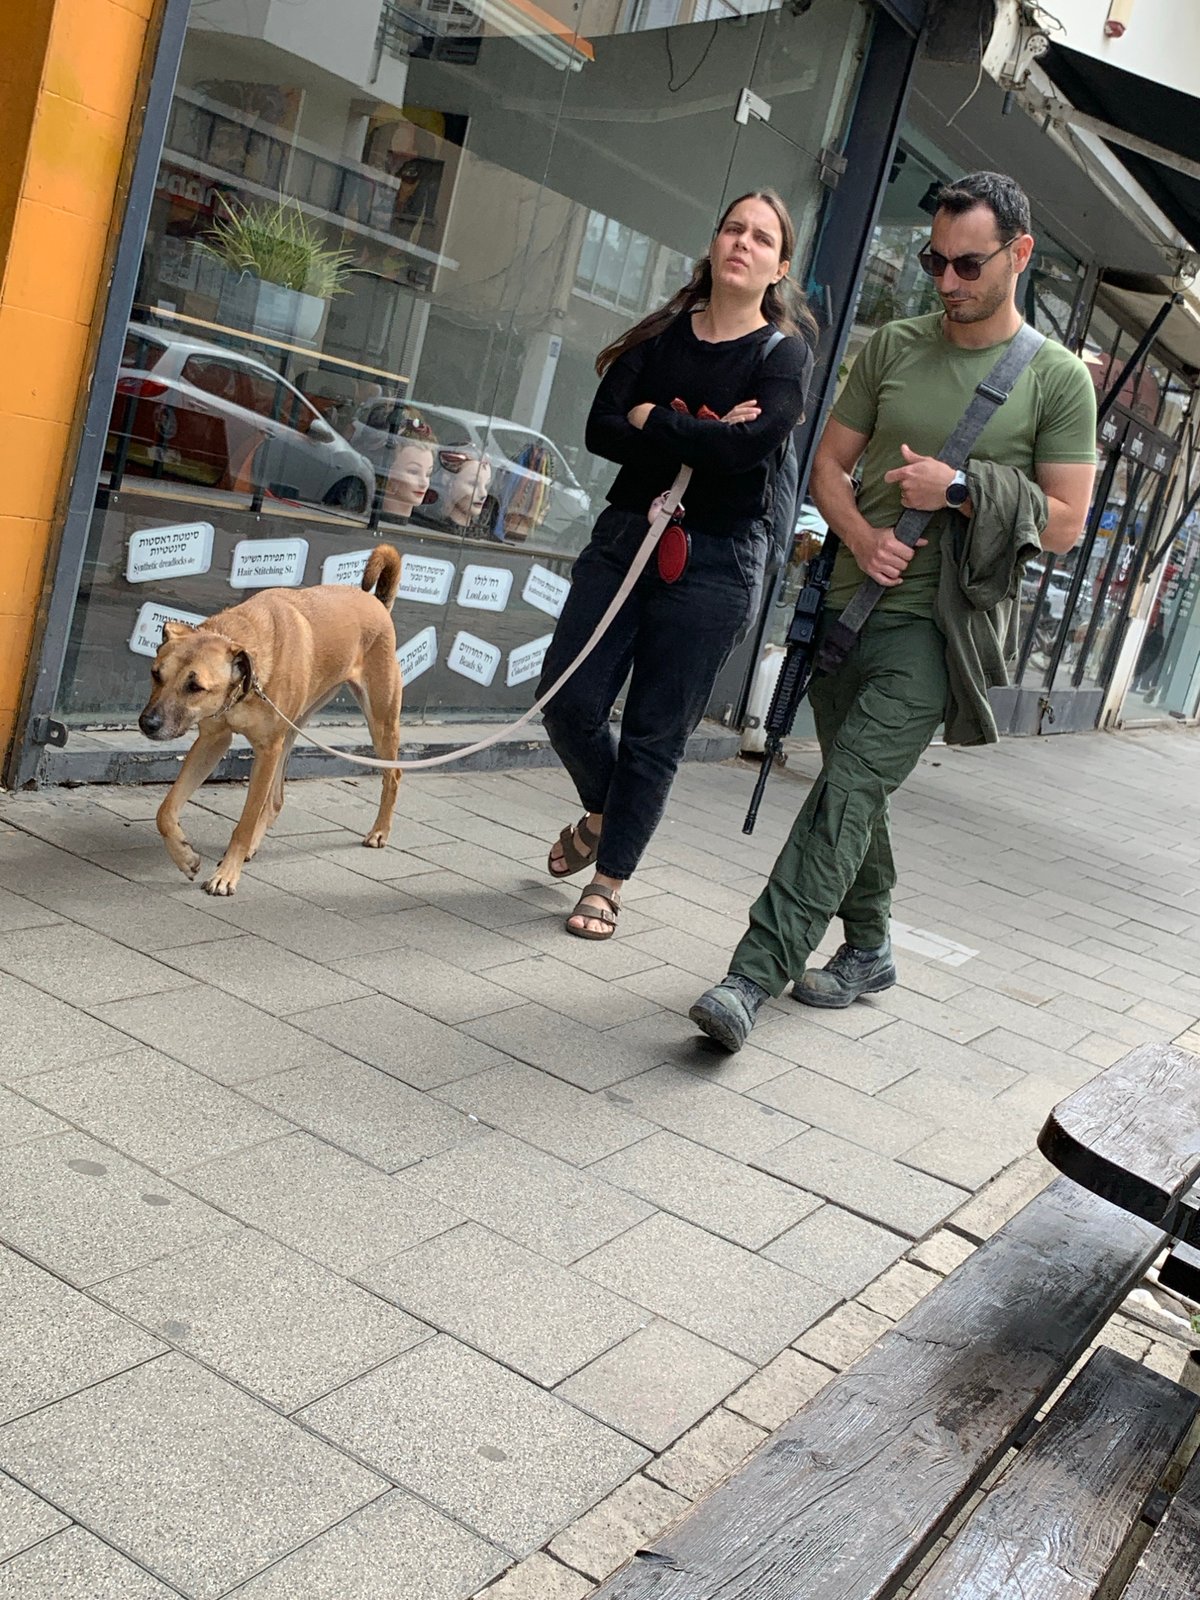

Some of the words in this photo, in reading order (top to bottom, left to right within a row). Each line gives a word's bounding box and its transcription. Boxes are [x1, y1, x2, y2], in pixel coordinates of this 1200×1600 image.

[139, 535, 171, 548] ראסטות
[173, 531, 200, 543] סימטת
[150, 543, 187, 556] סינטטיות
[236, 567, 253, 577] Hair
[253, 566, 284, 576] Stitching
[284, 565, 294, 574] St.
[474, 574, 488, 586] לולו
[465, 589, 490, 601] LooLoo
[138, 635, 150, 648] The
[406, 640, 428, 663] סמטת
